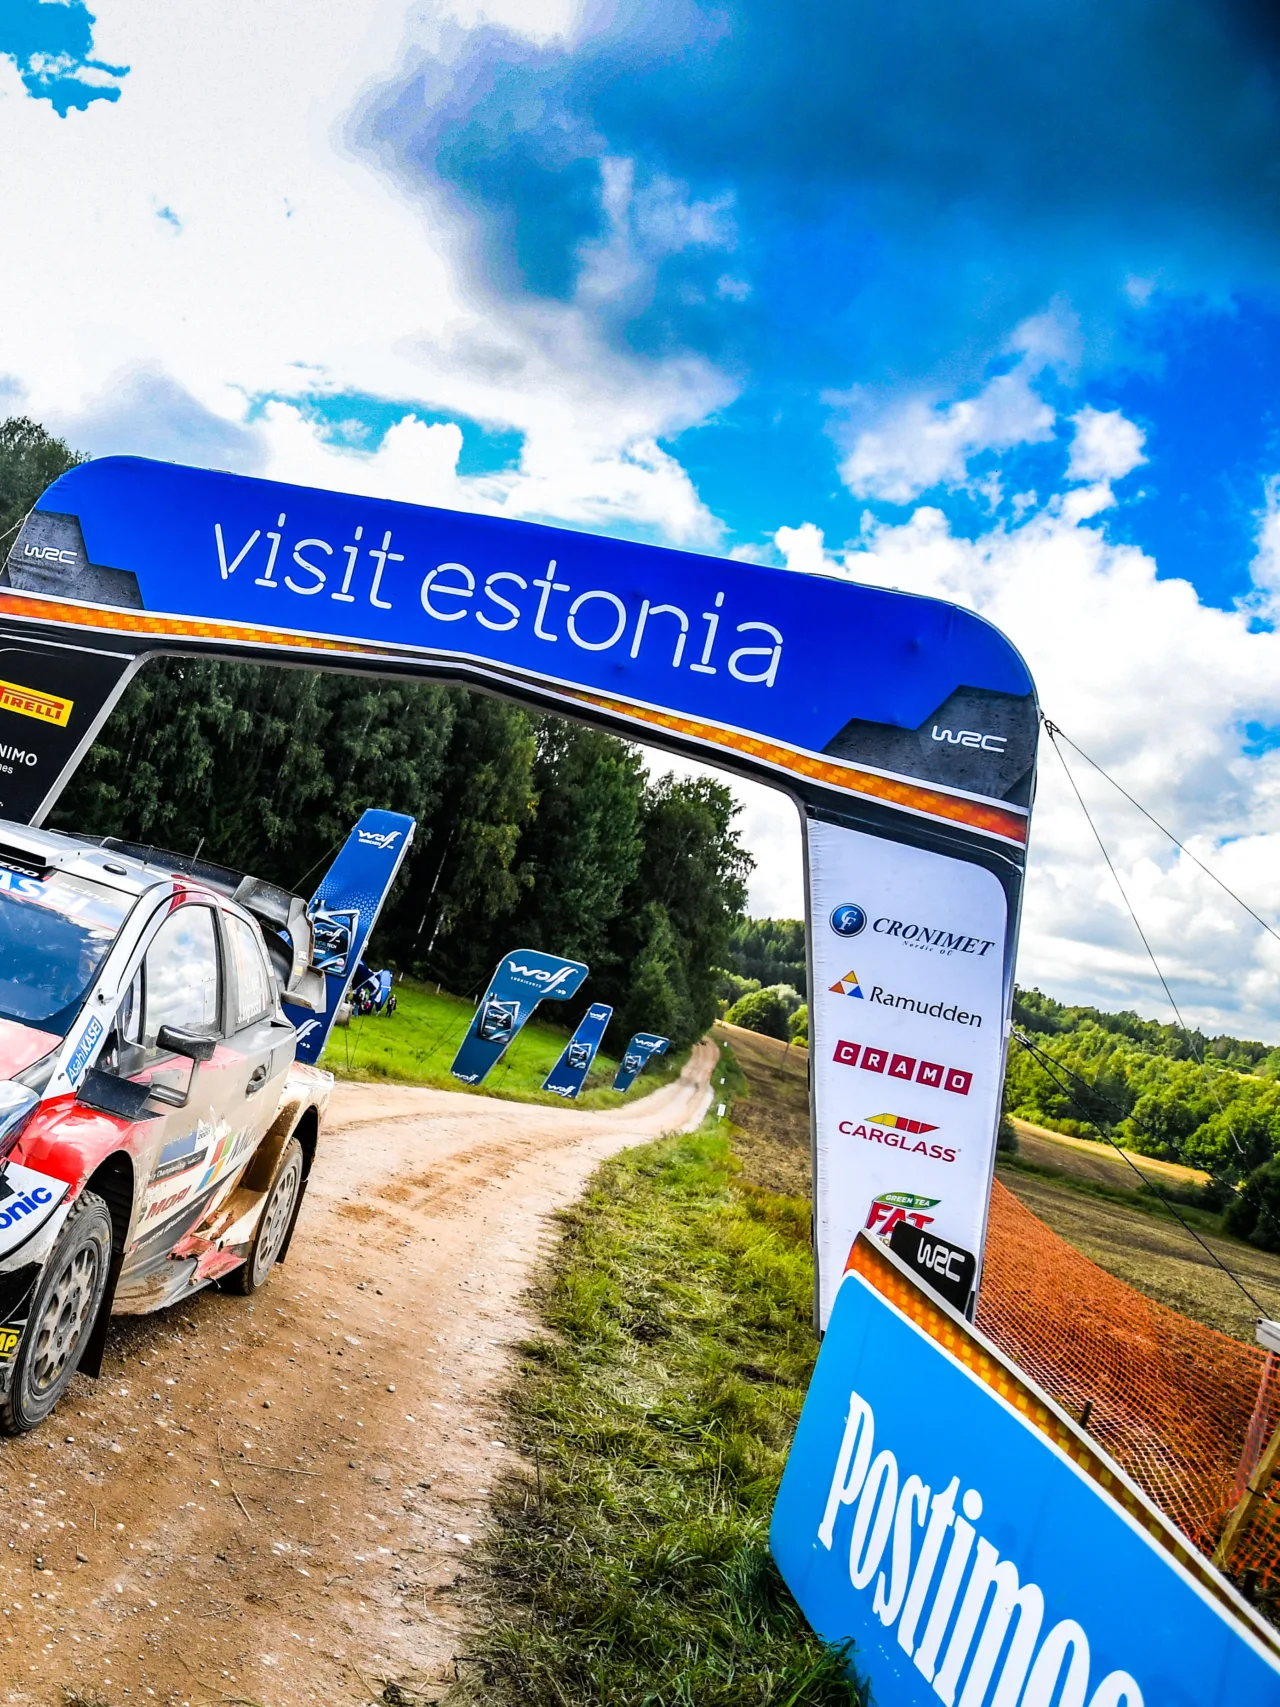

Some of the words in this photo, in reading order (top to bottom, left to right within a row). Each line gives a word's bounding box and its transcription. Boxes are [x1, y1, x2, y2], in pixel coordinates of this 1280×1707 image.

[24, 543, 78, 566] WRC
[214, 512, 405, 610] visit
[421, 560, 783, 688] estonia
[931, 724, 1008, 754] WRC
[872, 917, 996, 957] CRONIMET
[903, 940, 934, 952] Nordic
[508, 960, 579, 994] wolf
[869, 986, 983, 1028] Ramudden
[69, 1018, 102, 1083] AsahiKASEI
[838, 1045, 967, 1090] CRAMO
[838, 1121, 957, 1163] CARGLASS
[865, 1201, 935, 1236] FAT
[885, 1194, 913, 1205] GREEN
[914, 1199, 930, 1207] TEA
[916, 1237, 966, 1283] WRC
[818, 1390, 1146, 1707] Postime
